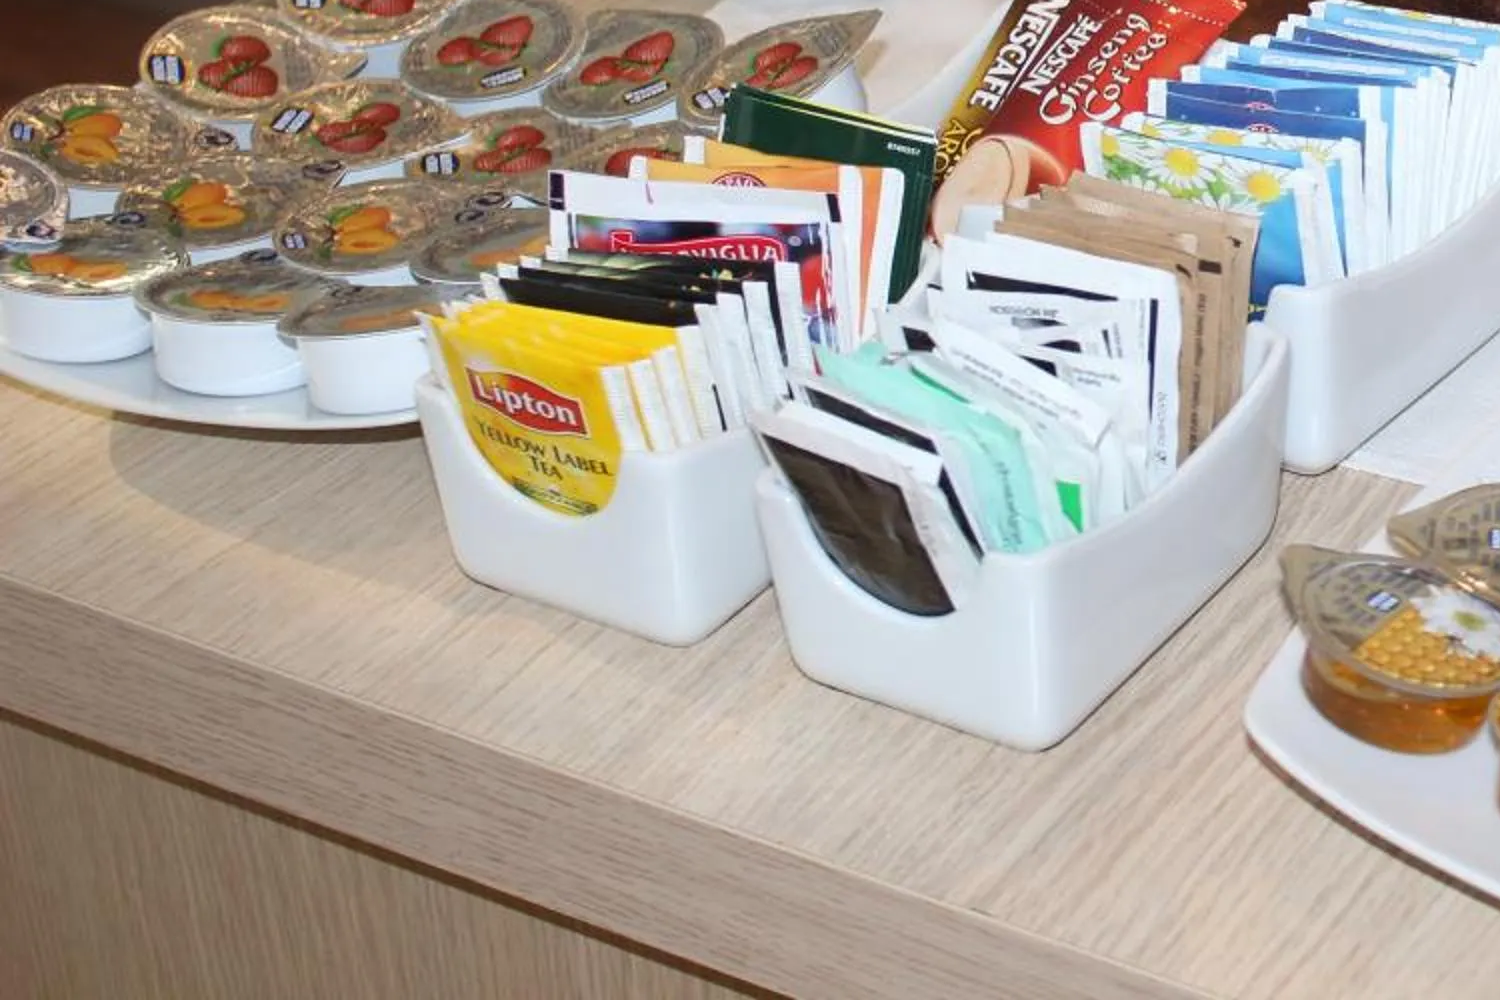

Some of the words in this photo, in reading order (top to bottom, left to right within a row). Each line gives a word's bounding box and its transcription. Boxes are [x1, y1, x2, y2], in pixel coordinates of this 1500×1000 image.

[1039, 12, 1150, 125] Ginseng
[1081, 31, 1167, 122] Coffee
[475, 375, 578, 427] Lipton
[475, 418, 545, 456] YELLOW
[552, 445, 613, 477] LABEL
[529, 455, 564, 481] TEA
